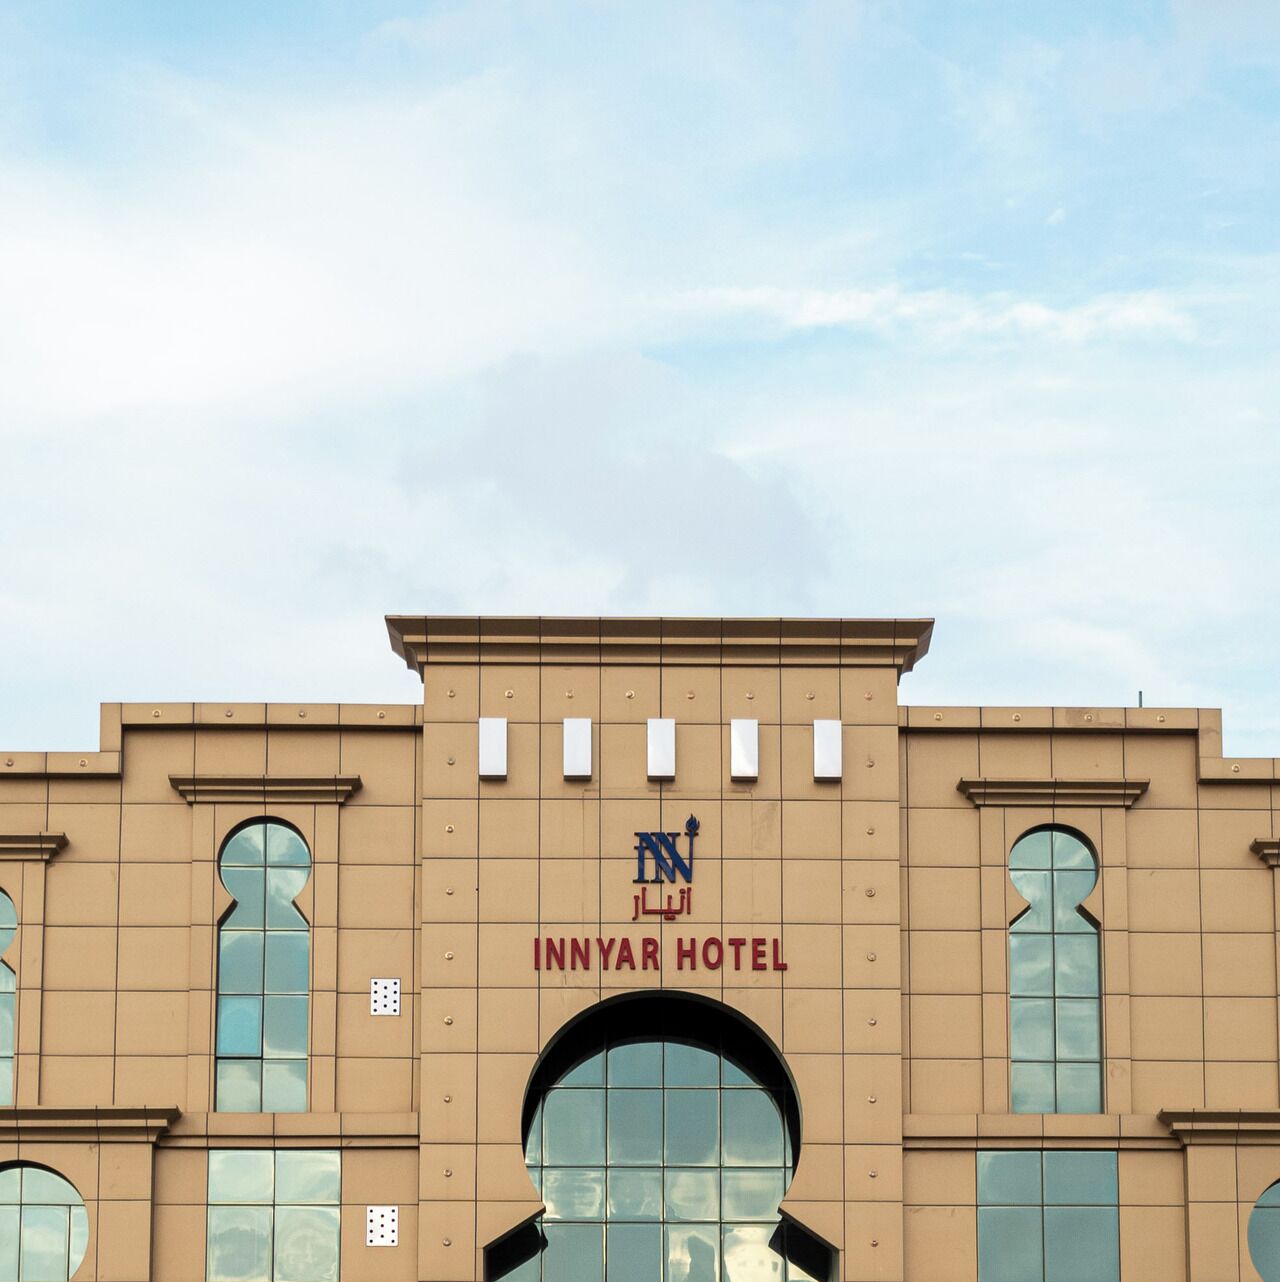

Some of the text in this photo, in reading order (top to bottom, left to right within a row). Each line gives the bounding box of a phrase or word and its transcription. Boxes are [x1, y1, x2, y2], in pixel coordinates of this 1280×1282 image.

[632, 886, 692, 921] انيار
[534, 937, 788, 971] INNYAR HOTEL
